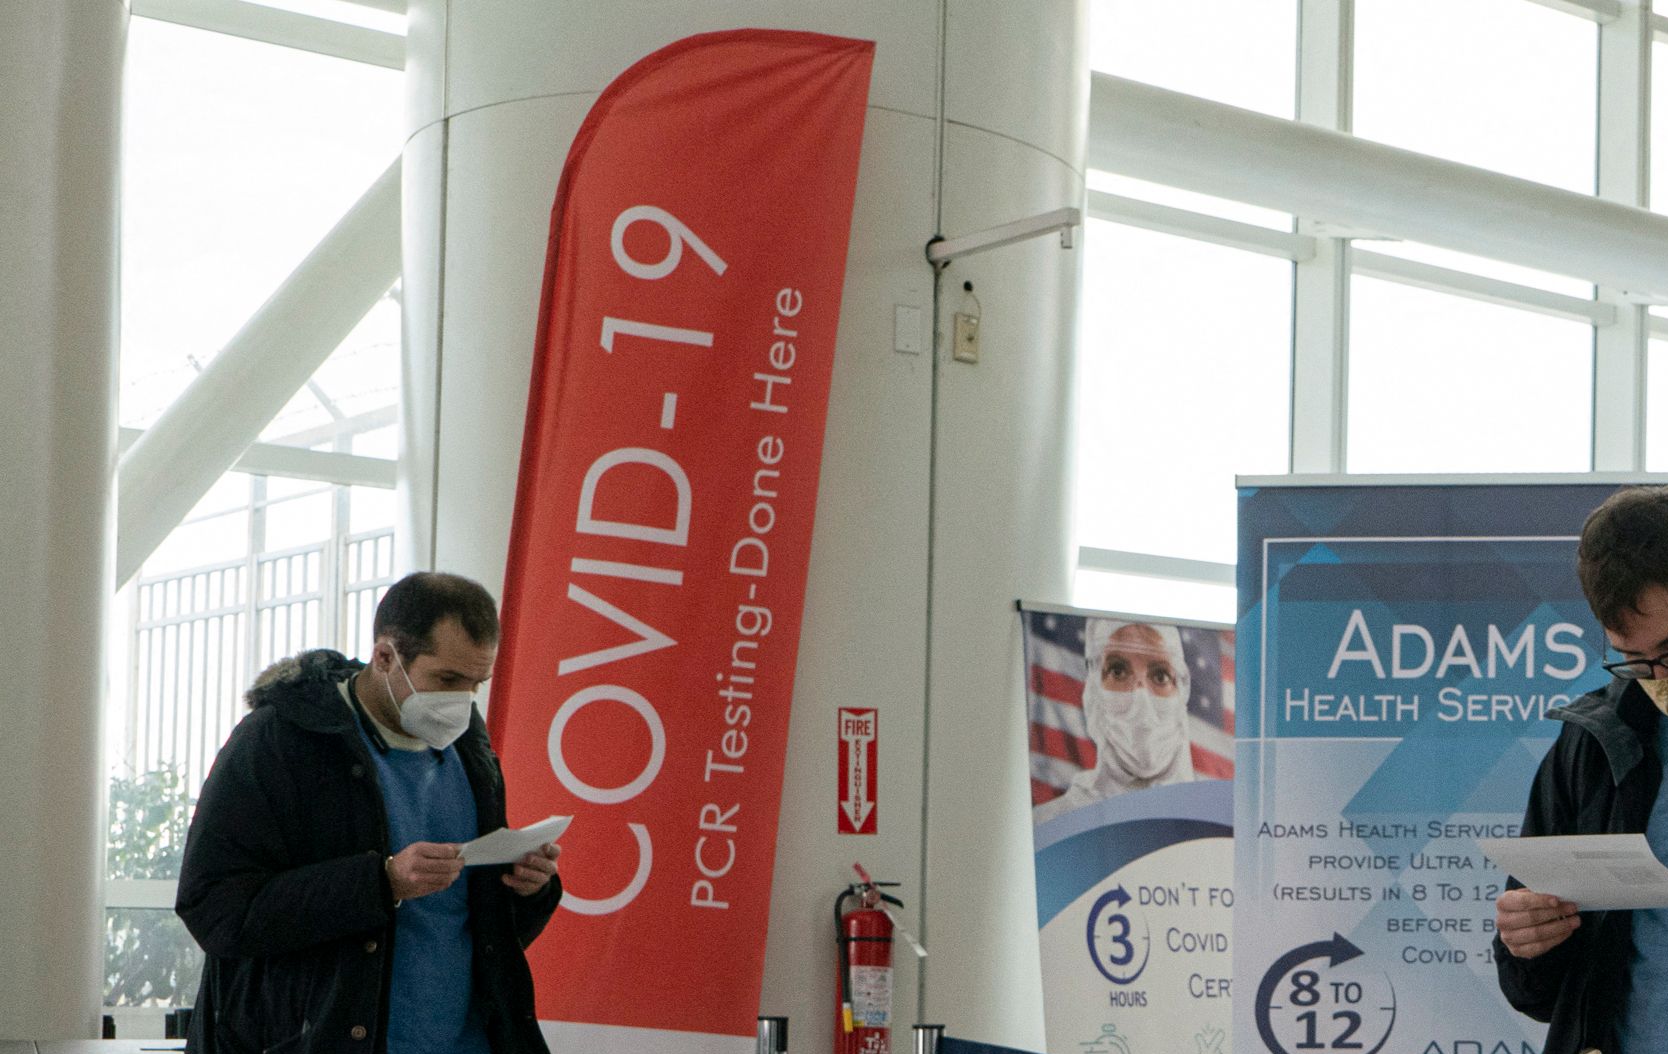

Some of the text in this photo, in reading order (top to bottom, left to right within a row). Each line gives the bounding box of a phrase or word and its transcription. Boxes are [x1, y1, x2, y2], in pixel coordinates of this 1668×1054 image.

[547, 205, 728, 915] COVID-19
[691, 287, 803, 911] PCR Testing-Done Here
[1327, 609, 1587, 679] ADAMS
[1285, 686, 1582, 722] HEALTH SERVIC
[845, 719, 871, 736] FIRE
[1257, 822, 1328, 839] ADAMS
[1338, 821, 1418, 839] HEALTH
[1308, 855, 1400, 870] PROVIDE
[1409, 853, 1474, 870] ULTRA
[1138, 882, 1235, 908] DON'T FO
[1273, 884, 1372, 901] (RESULTS
[1382, 887, 1401, 901] IN
[1411, 884, 1428, 900] 8
[1472, 885, 1498, 901] 12
[1386, 917, 1473, 933] BEFORE
[1108, 914, 1135, 966] 3
[1166, 927, 1229, 953] COVID
[1402, 946, 1468, 964] COVID
[1188, 973, 1234, 998] CER
[1288, 970, 1363, 1006] 8 TO
[1109, 991, 1148, 1007] HOURS
[1295, 1010, 1364, 1050] 12
